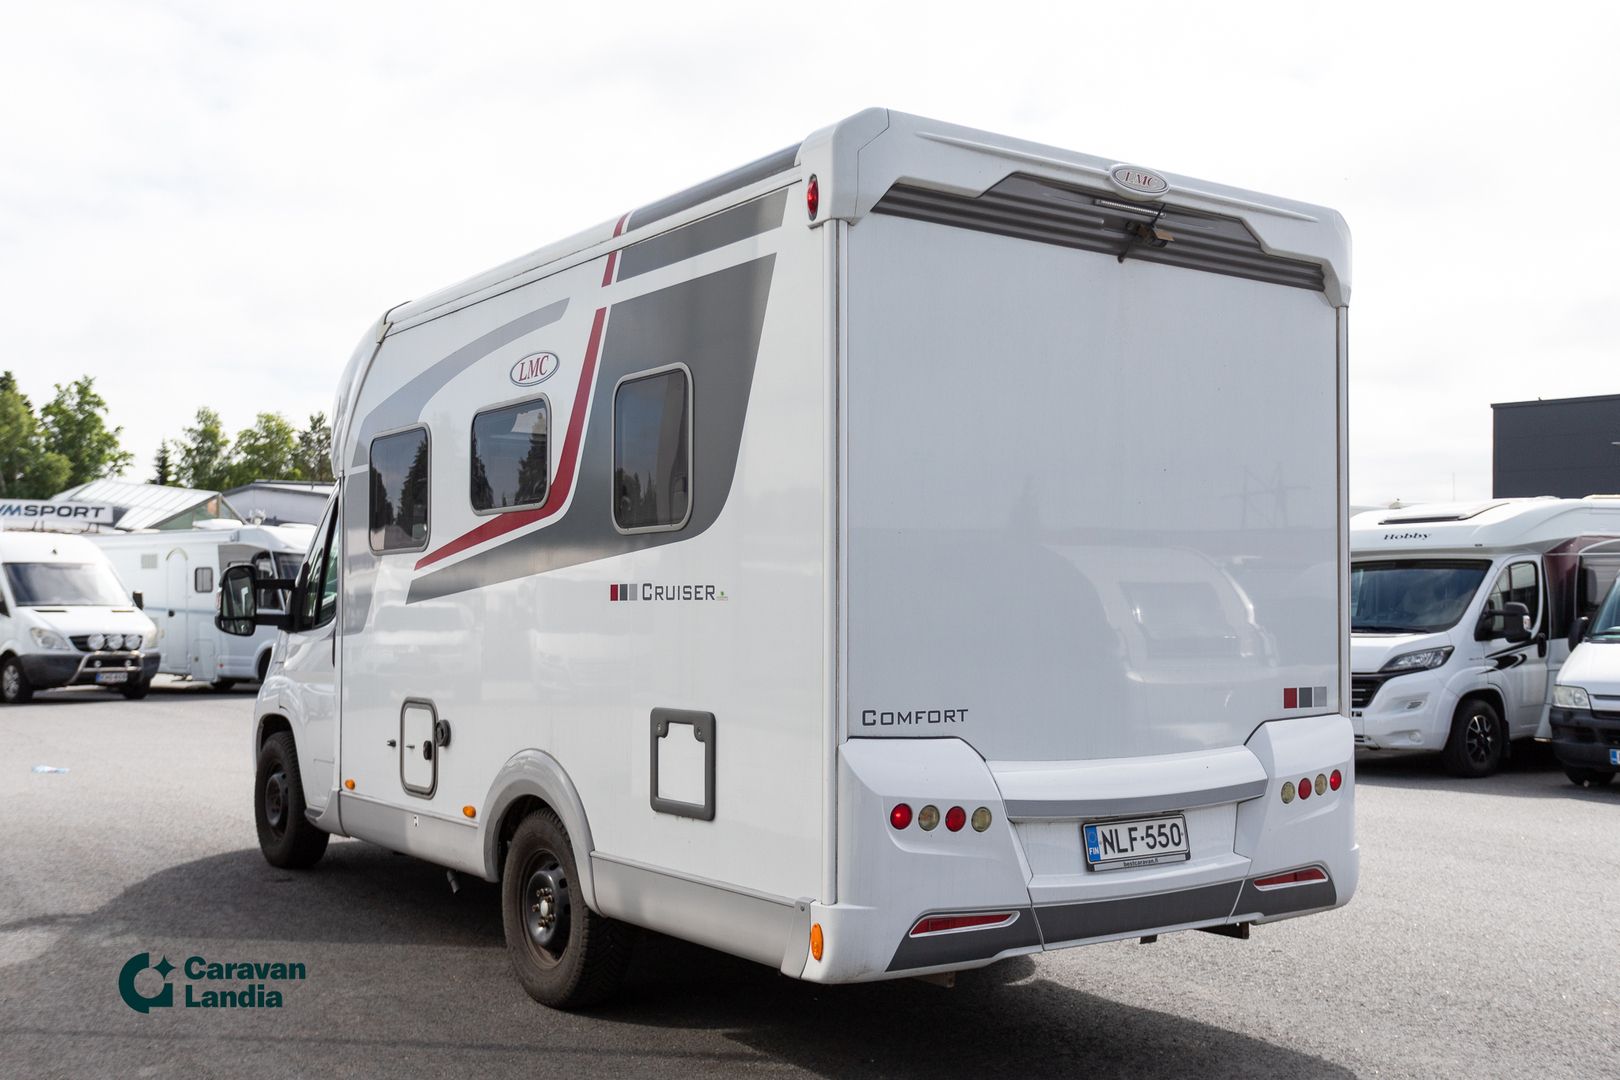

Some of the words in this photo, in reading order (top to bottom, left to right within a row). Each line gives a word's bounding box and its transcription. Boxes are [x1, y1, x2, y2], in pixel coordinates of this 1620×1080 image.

[518, 355, 549, 382] LMC
[642, 583, 716, 601] CRUISER
[862, 708, 969, 727] COMFORT
[1089, 847, 1100, 856] FIN
[1101, 822, 1182, 855] NLF-550
